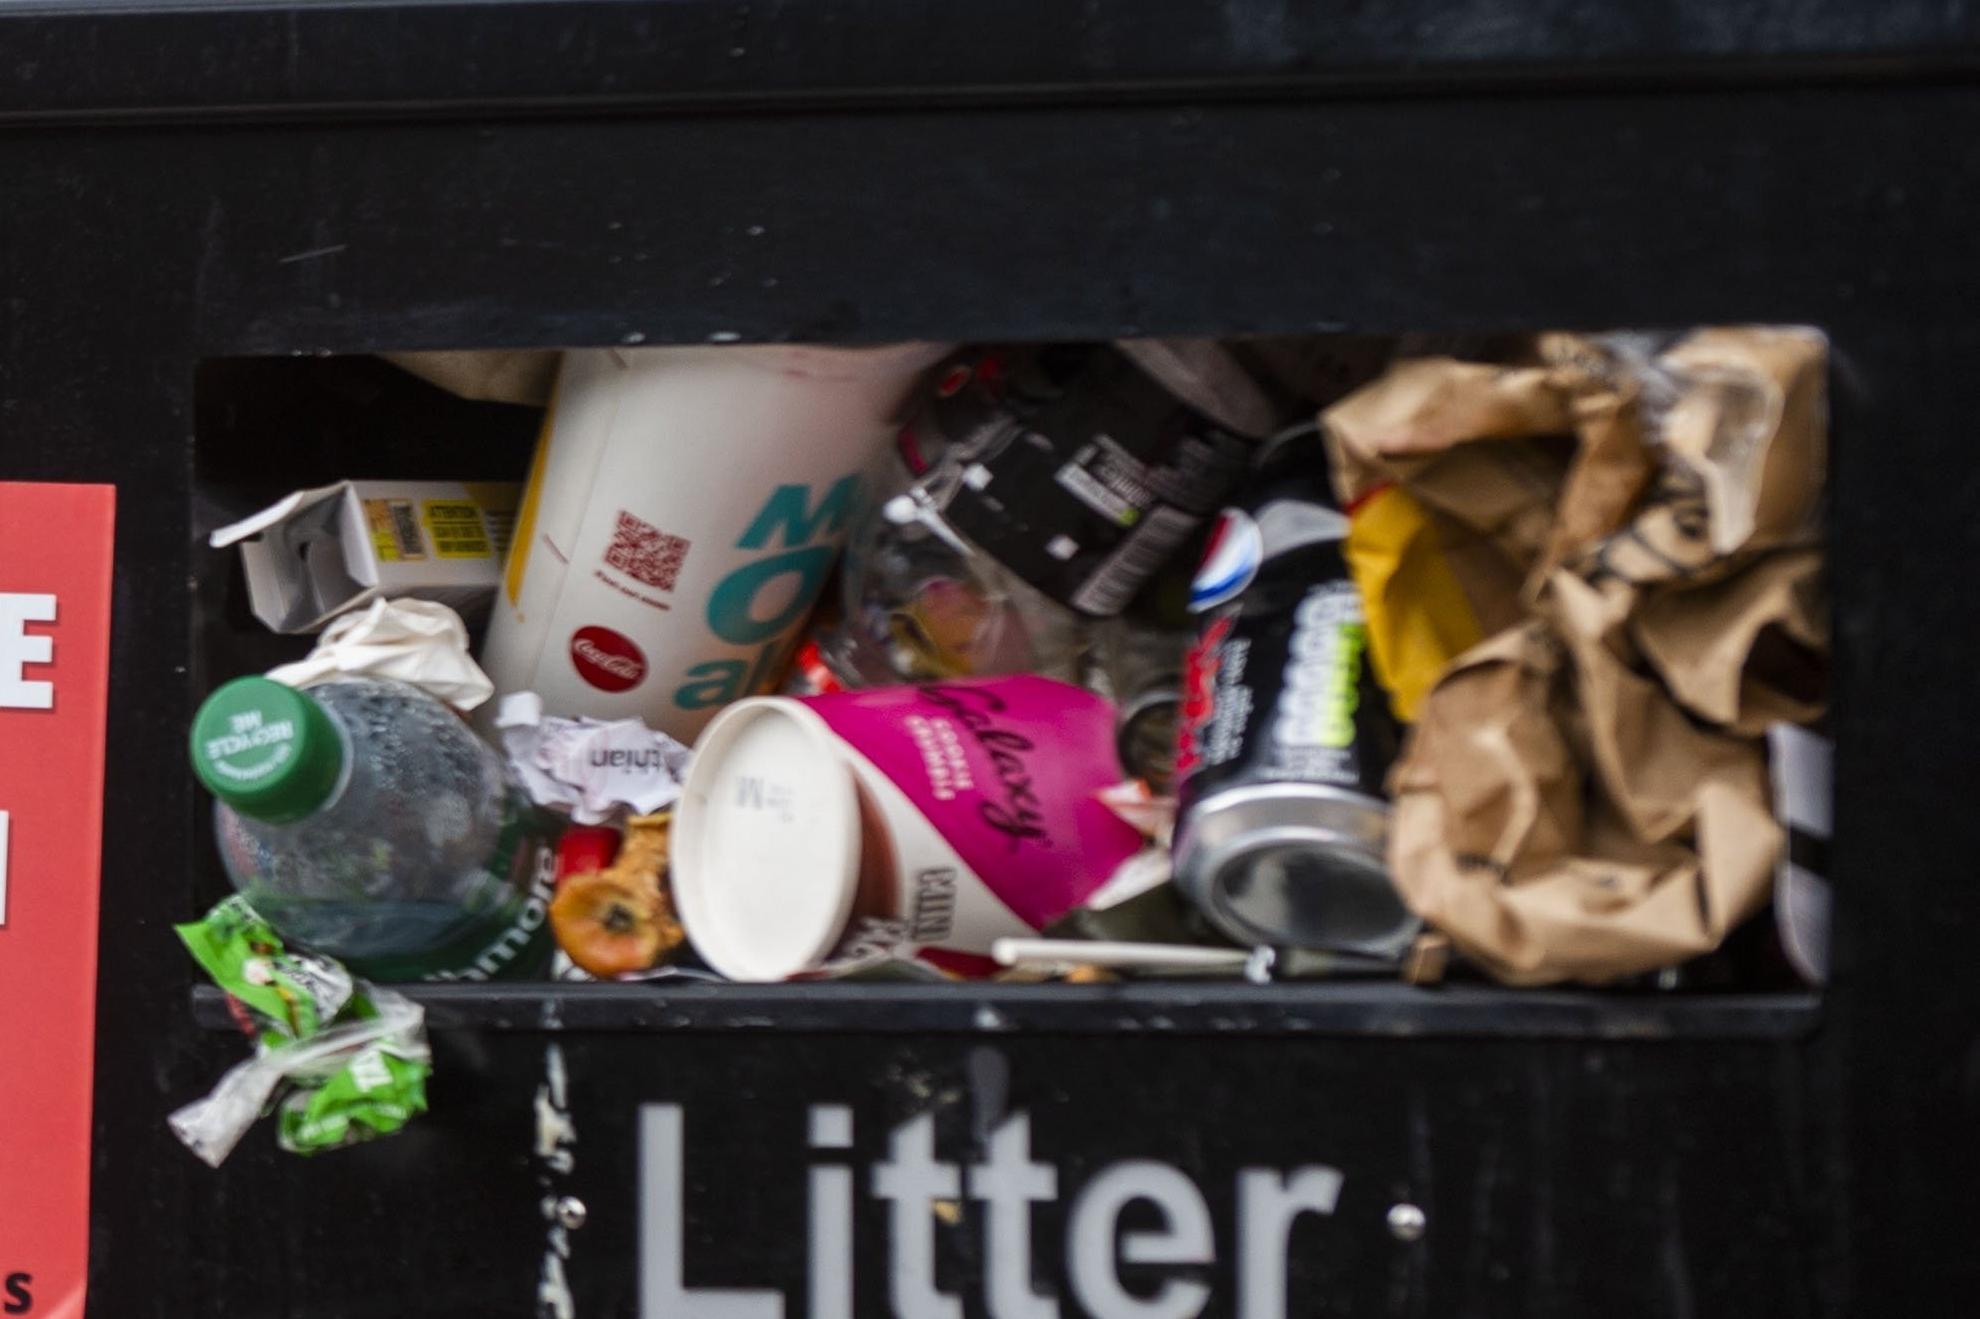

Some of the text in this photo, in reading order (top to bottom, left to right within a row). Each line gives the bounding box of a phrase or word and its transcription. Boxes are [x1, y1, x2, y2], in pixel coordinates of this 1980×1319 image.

[205, 720, 294, 760] RECYCLE
[917, 684, 1048, 853] Galaxy
[638, 1103, 1343, 1319] Litter
